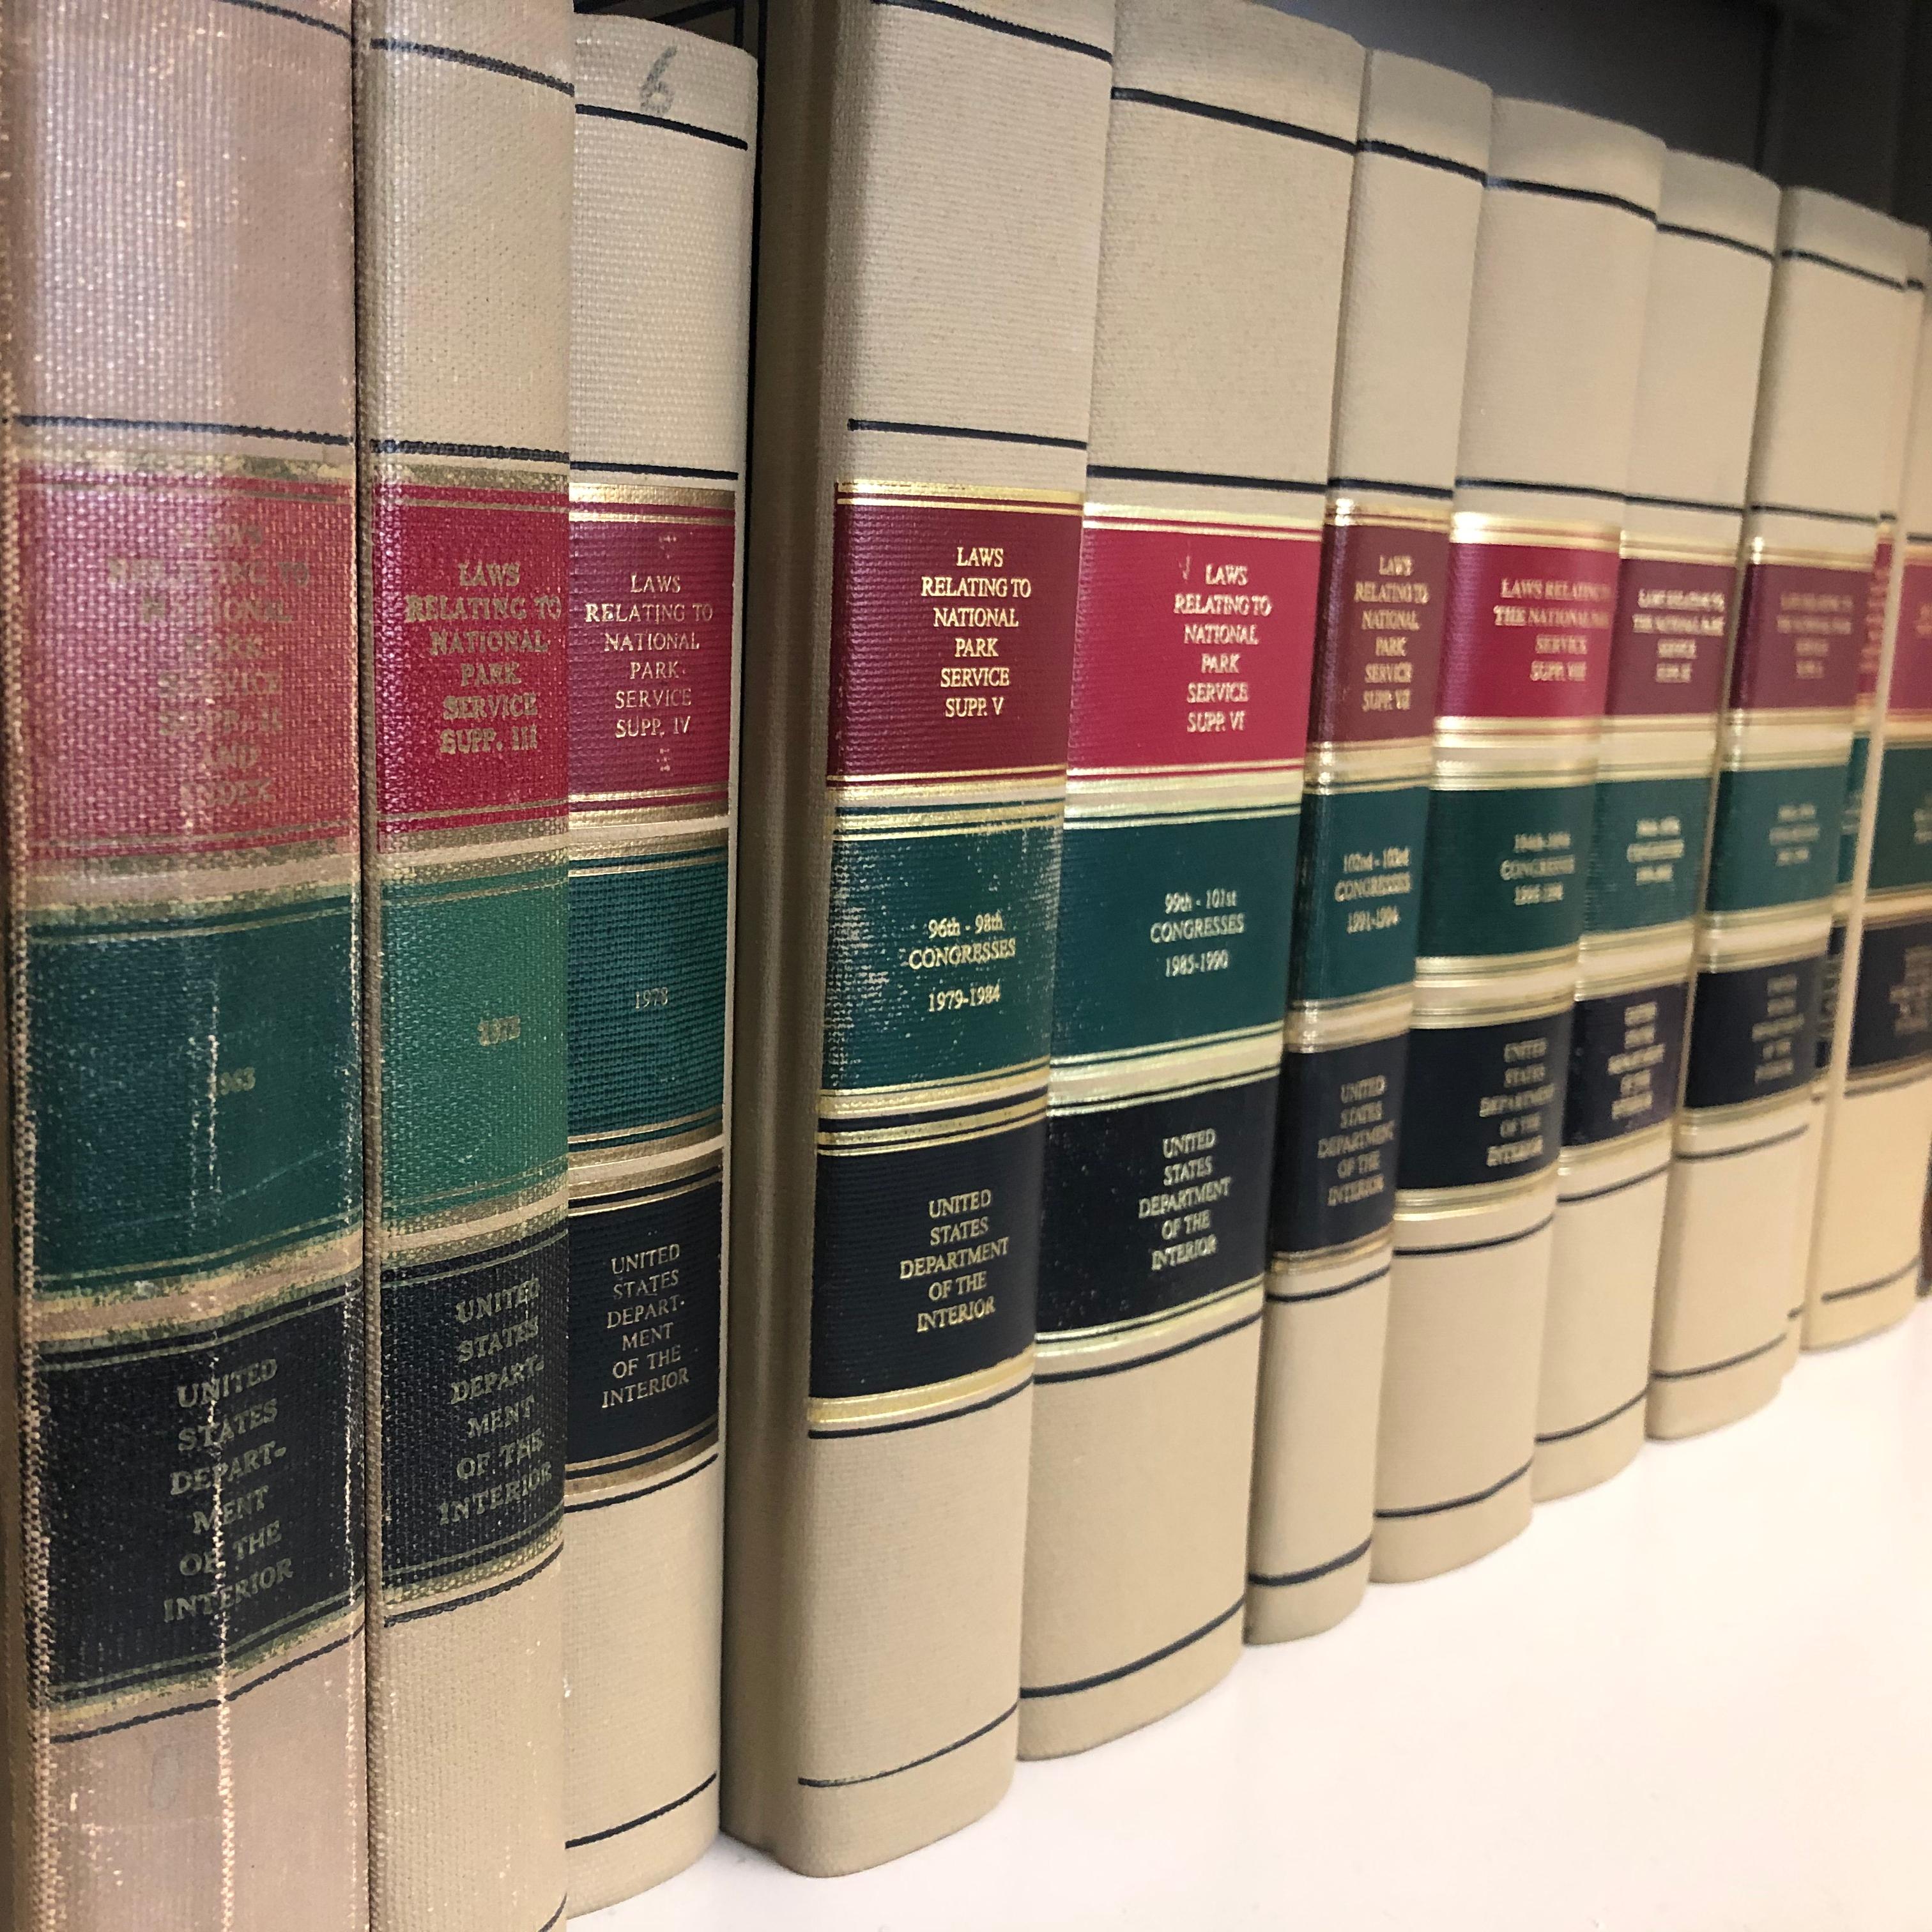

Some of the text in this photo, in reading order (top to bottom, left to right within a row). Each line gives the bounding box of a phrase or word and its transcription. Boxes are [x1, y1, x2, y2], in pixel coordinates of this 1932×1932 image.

[956, 547, 1004, 567] LAWS
[1379, 555, 1414, 576] LAWS
[457, 562, 521, 586] LAWS
[630, 574, 681, 594] LAWS
[921, 576, 1031, 597] RELATING TO
[1206, 564, 1248, 586] LAWS
[1354, 581, 1412, 603] RELATING
[1501, 578, 1543, 599] LAWS
[404, 595, 561, 622] RELATING TO
[585, 602, 714, 624] RELATING TO
[933, 608, 1018, 627] NATIONAL
[1174, 593, 1273, 617] RELATING TO
[1361, 609, 1420, 631] NATIONAL
[430, 629, 548, 656] NATIONAL
[604, 632, 700, 652] NATIONAL
[954, 638, 999, 657] PARK
[1184, 624, 1259, 645] NATIONAL
[460, 661, 522, 687] PARK
[629, 661, 680, 680] PARK
[940, 667, 1010, 687] SERVICE
[1201, 653, 1241, 673] PARK
[615, 688, 692, 709] SERVICE
[1187, 682, 1248, 703] SERVICE
[442, 693, 538, 721] SERVICE
[945, 697, 1004, 717] SUPP. V
[615, 716, 691, 738] SUPP. IV
[1187, 710, 1246, 733] SUPP. VI
[440, 723, 538, 755] SUPP. III
[1165, 892, 1193, 914] 99th
[1206, 888, 1238, 909] 101st
[928, 917, 960, 939] 96th
[974, 911, 1004, 934] 98th
[1150, 912, 1245, 944] CONGRESSES
[908, 938, 1016, 970] CONGRESSES
[929, 982, 1001, 1012] 1979-1984
[1163, 1128, 1217, 1159] UNITED
[1163, 1156, 1213, 1186] STATES
[928, 1189, 992, 1218] UNITED
[1138, 1176, 1231, 1219] DEPARTMENT
[930, 1216, 989, 1246] STATES
[1162, 1209, 1212, 1240] OF THE
[611, 1243, 680, 1275] UNITED
[900, 1237, 1009, 1280] DEPARTMENT
[1151, 1234, 1218, 1271] INTERIOR
[613, 1269, 680, 1300] STATES
[928, 1270, 987, 1301] OF THE
[456, 1277, 540, 1323] UNITED
[917, 1296, 996, 1333] INTERIOR
[457, 1317, 539, 1363] STATES
[622, 1322, 674, 1351] MENT
[611, 1344, 682, 1379] OF THE
[177, 1359, 278, 1407] UNITED
[601, 1367, 690, 1409] INTERIOR
[178, 1398, 279, 1452] STATES
[467, 1395, 535, 1439] MENT
[456, 1428, 544, 1482] OF THE
[439, 1462, 552, 1525] INTERIOR
[232, 1521, 282, 1561] THE
[164, 1558, 293, 1623] INTERIOR
